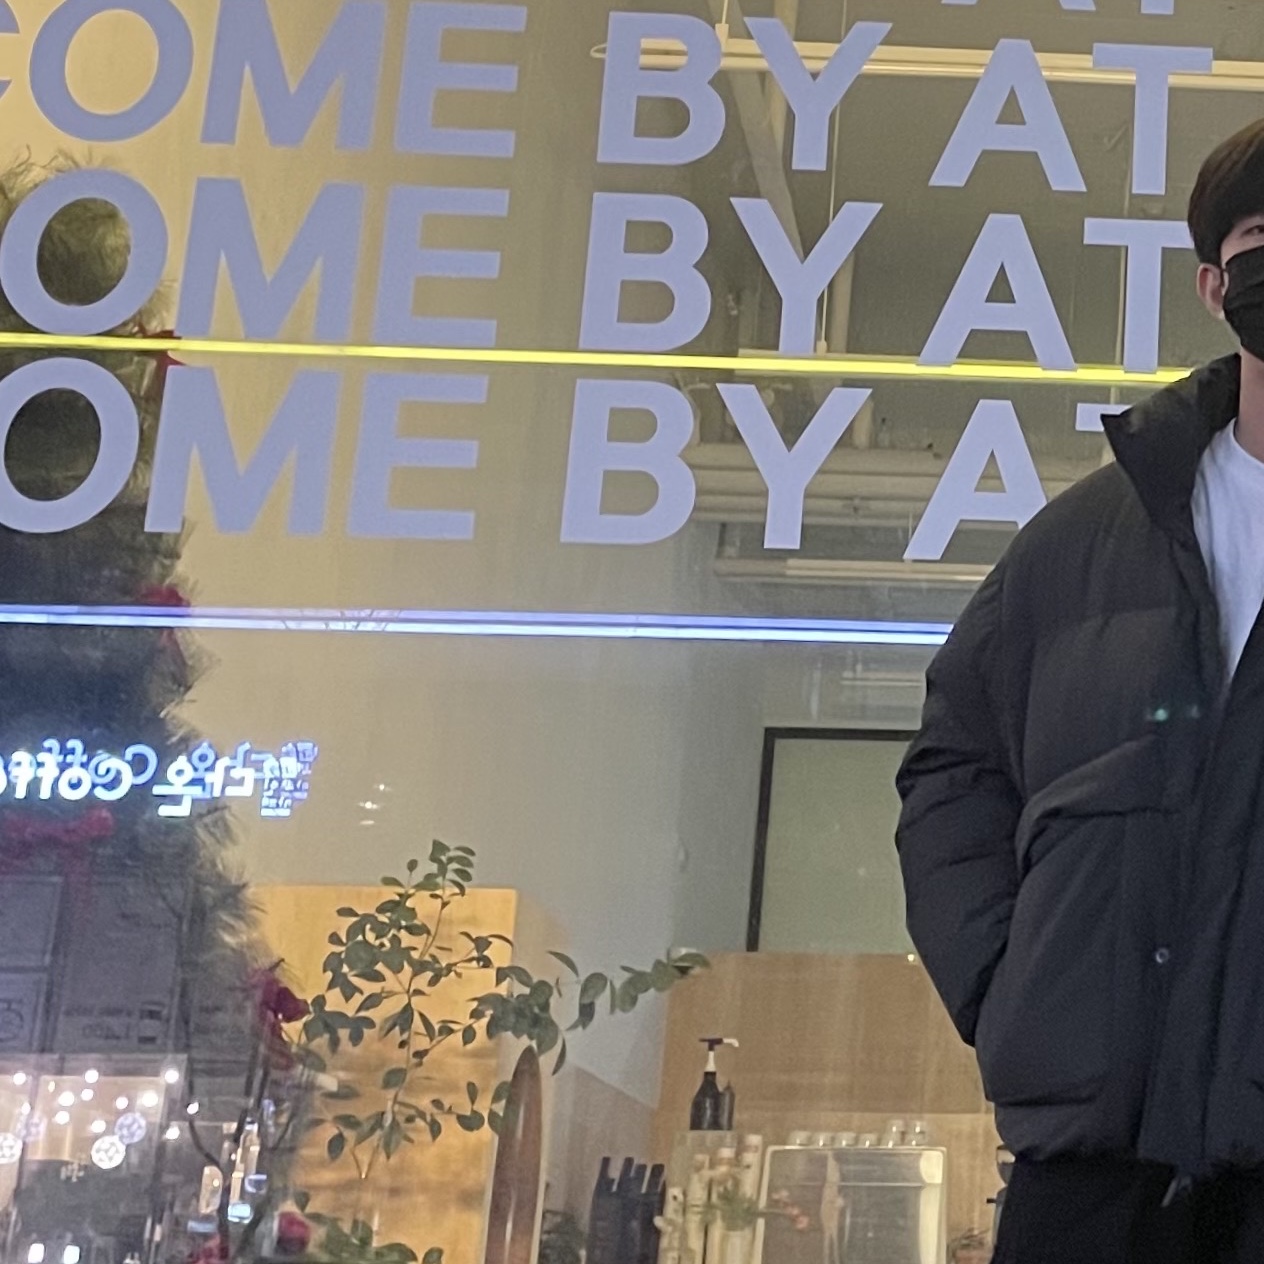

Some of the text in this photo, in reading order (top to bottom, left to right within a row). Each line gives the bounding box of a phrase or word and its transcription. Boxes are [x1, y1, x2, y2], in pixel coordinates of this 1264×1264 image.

[597, 11, 893, 171] BY
[929, 39, 1213, 195] AT
[579, 192, 884, 357] BY
[917, 213, 1195, 375] AT
[560, 378, 872, 549] BY
[903, 398, 1135, 561] A
